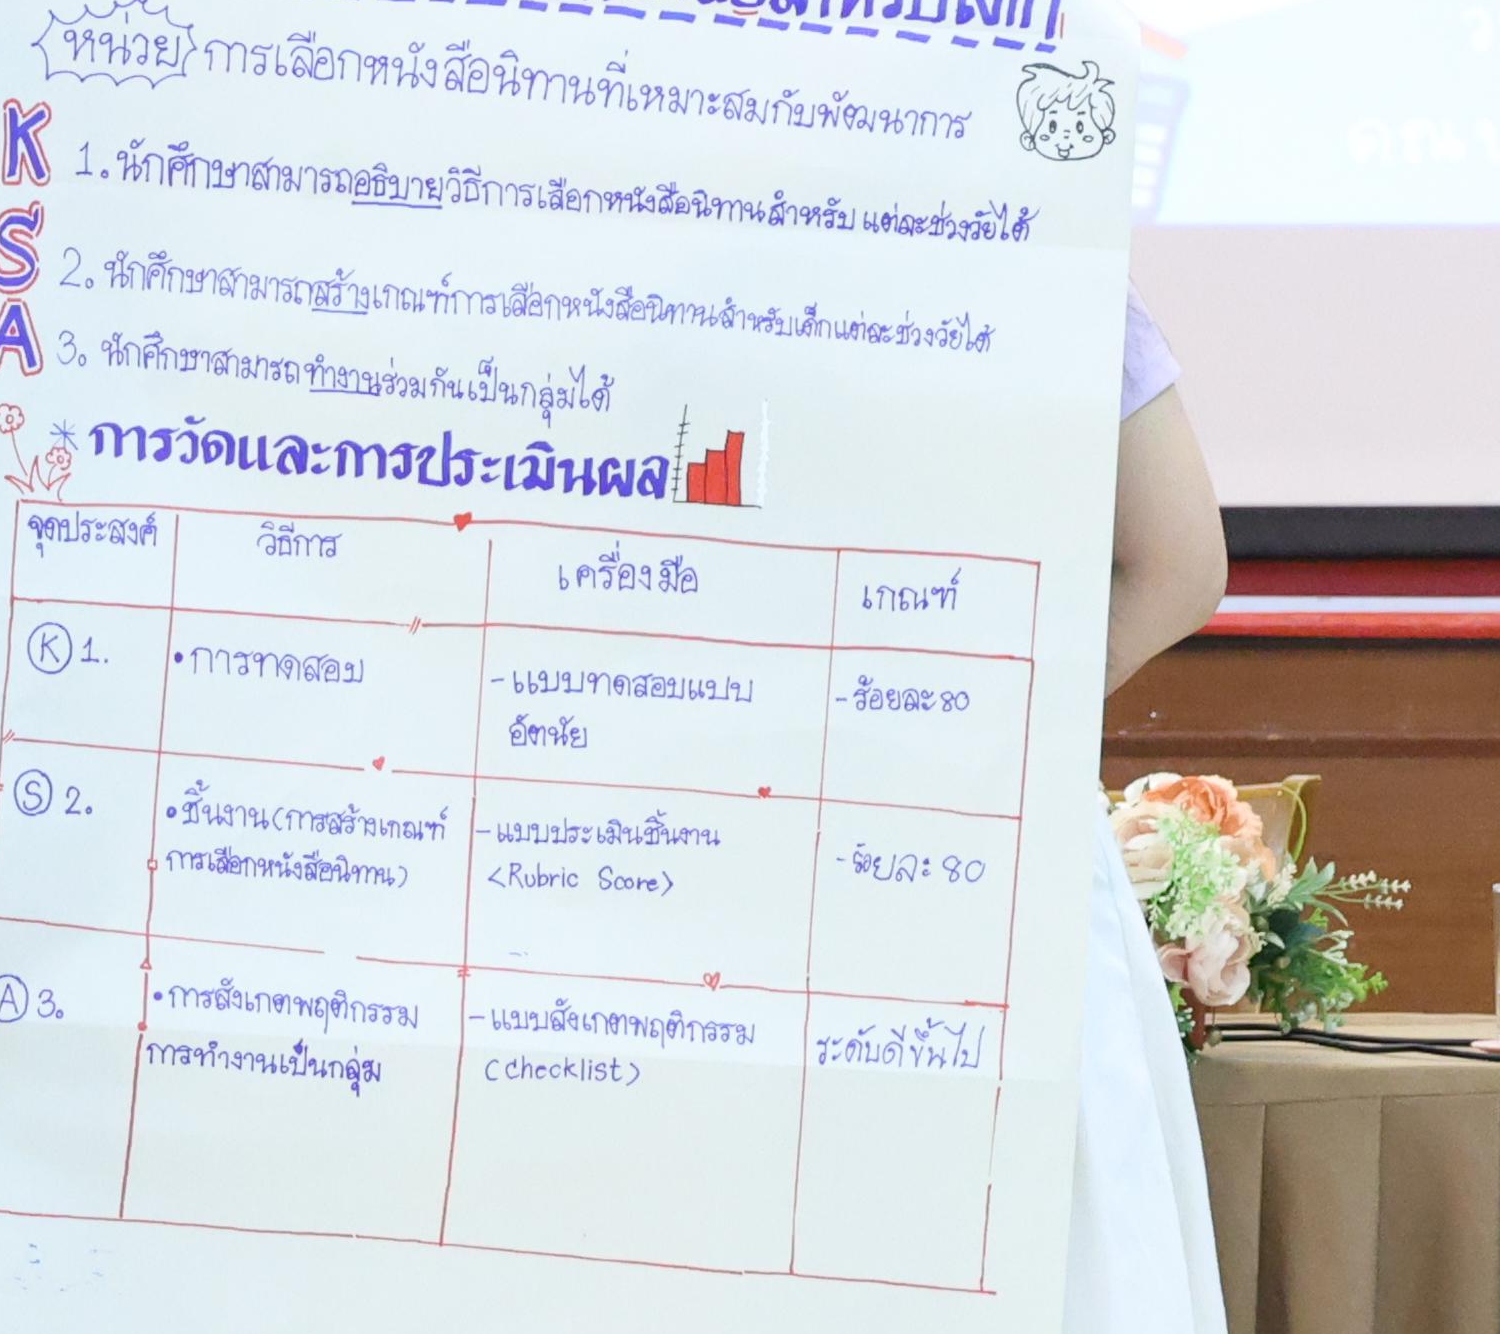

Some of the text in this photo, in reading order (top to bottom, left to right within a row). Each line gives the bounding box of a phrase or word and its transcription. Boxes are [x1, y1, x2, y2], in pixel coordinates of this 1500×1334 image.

[63, 11, 182, 69] หน่วย
[2, 98, 52, 187] K
[88, 415, 671, 500] การวัดและการประเมินผล
[26, 510, 159, 559] จุดประสงค์
[256, 521, 344, 559] วิธีการ
[557, 539, 700, 594] เครื่องมือ
[861, 567, 962, 612] เกณฑ์
[190, 646, 365, 684] การทดสอบ
[509, 714, 588, 749] อัตนัย
